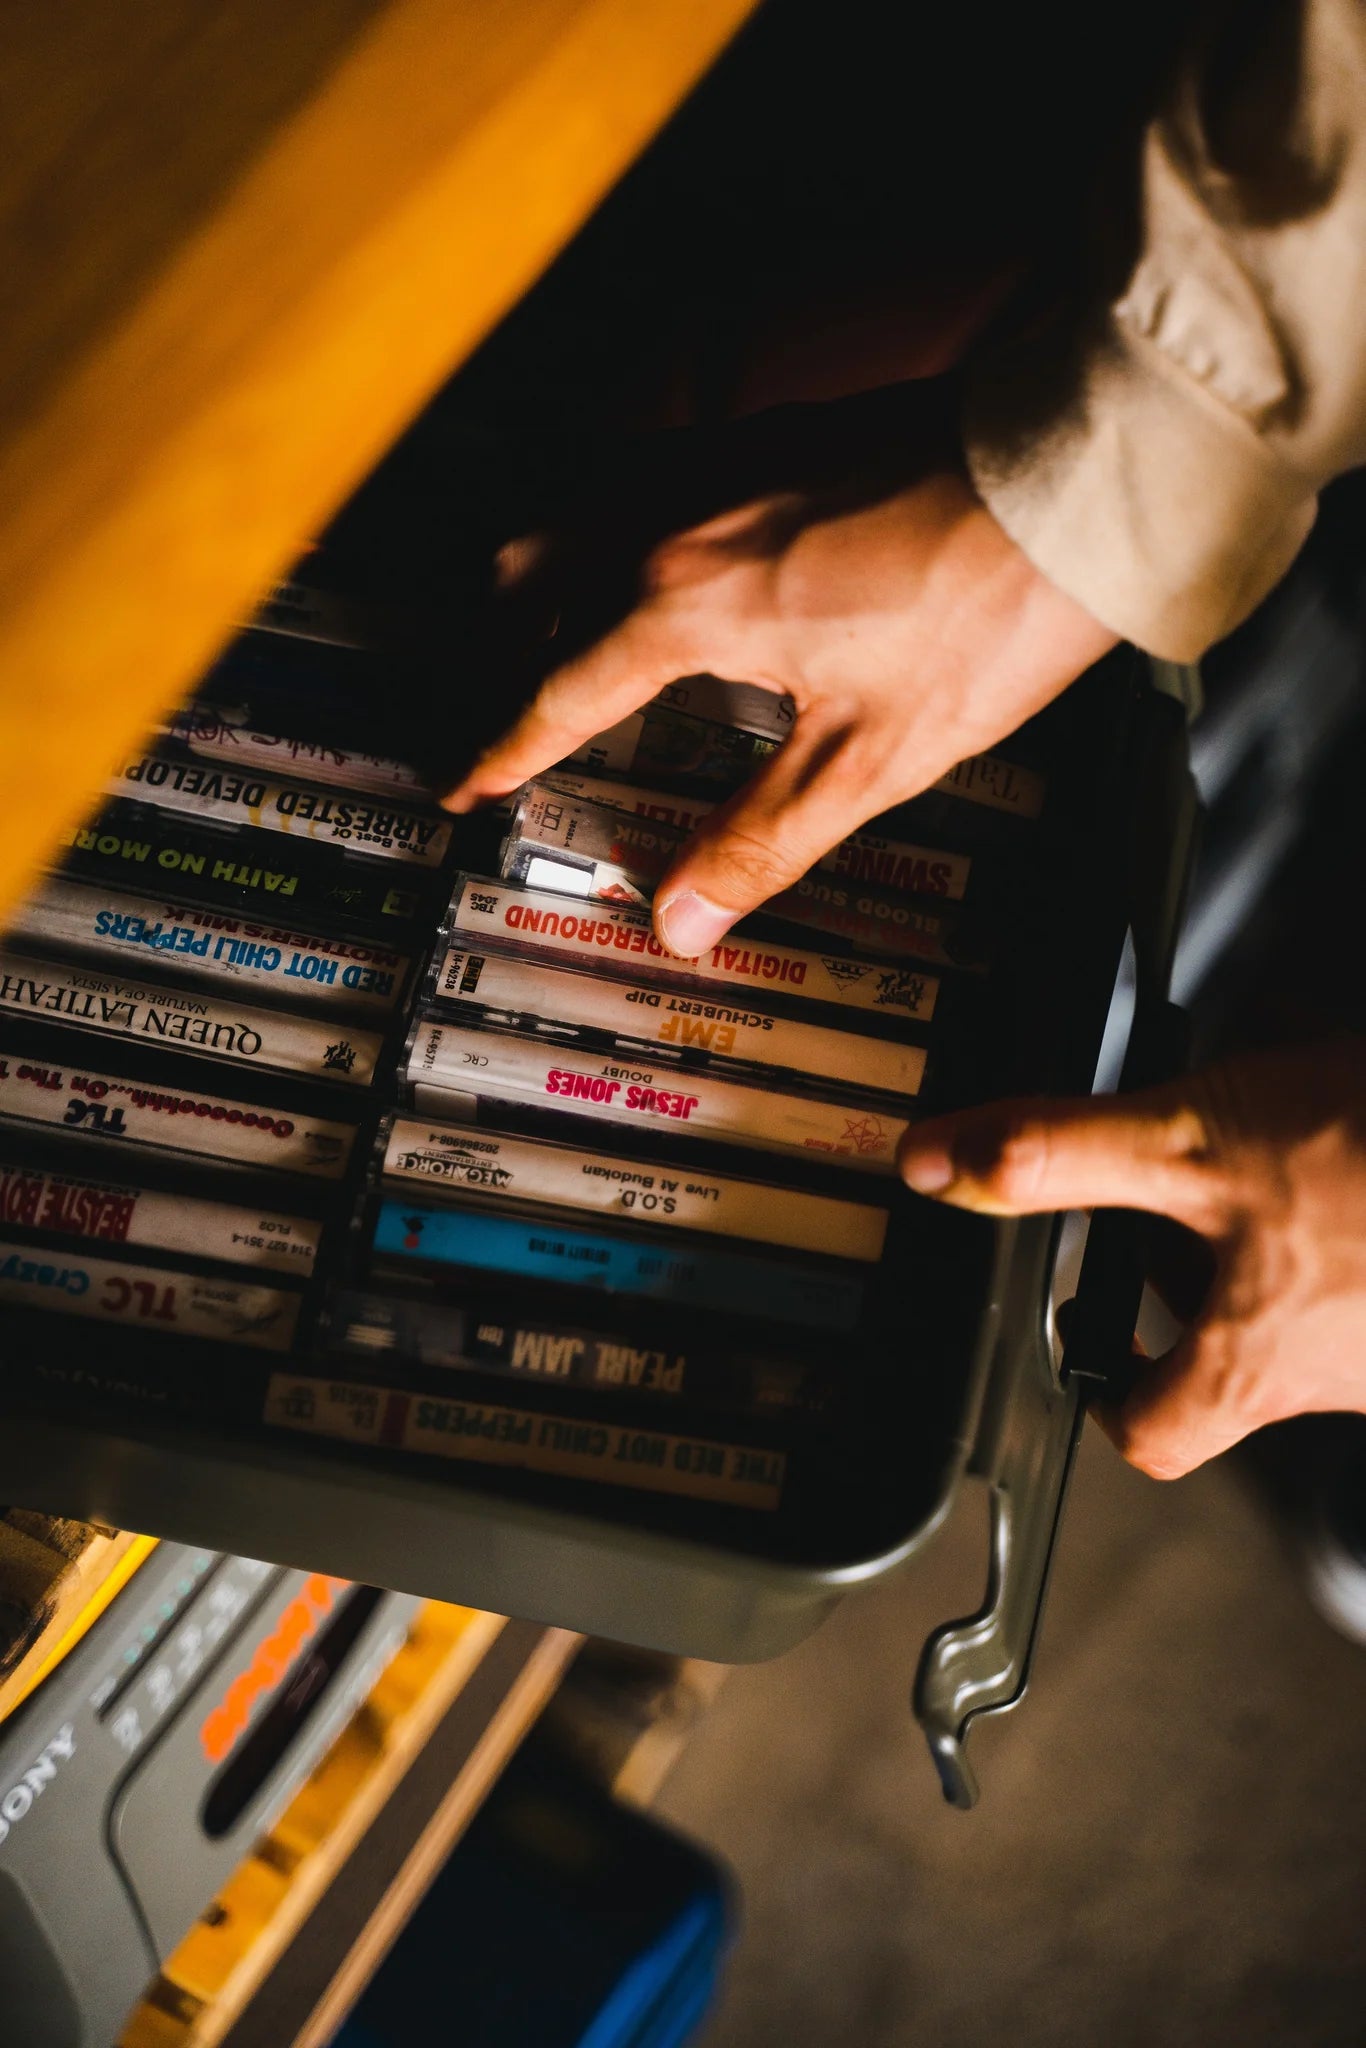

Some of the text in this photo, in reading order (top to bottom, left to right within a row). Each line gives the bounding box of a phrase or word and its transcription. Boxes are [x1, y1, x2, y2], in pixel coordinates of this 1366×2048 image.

[110, 753, 438, 847] ARRESTED DEVELOP
[330, 824, 429, 856] The Best Of
[154, 844, 208, 877] NO
[209, 857, 299, 896] FAITH
[833, 842, 954, 897] SWING
[468, 891, 498, 905] 1045
[469, 900, 495, 914] TBC
[795, 877, 849, 908] SUG
[502, 903, 702, 966] DERGROUND
[853, 894, 941, 936] BLOOD
[92, 908, 395, 997] RED HOT CHILI PEPPERS
[160, 904, 402, 969] MOTHER'S MILK
[443, 951, 464, 991] E4-96238
[710, 943, 808, 985] DIGITAL
[112, 984, 123, 996] A
[122, 986, 145, 1001] OF
[145, 990, 208, 1016] NATURE
[623, 988, 775, 1031] SCHUBERT DIP
[0, 974, 264, 1058] QUEEN LATIFAH
[656, 1012, 738, 1054] EMF
[14, 1063, 64, 1091] The
[461, 1052, 489, 1067] CRC
[599, 1064, 653, 1084] DOUBT
[543, 1068, 700, 1121] JESUS JONES
[61, 1097, 129, 1134] TLC
[394, 1152, 515, 1189] MEGAFORCE
[421, 1149, 493, 1167] ENTERTAINMENT
[580, 1162, 720, 1201] Live At Budokan
[615, 1186, 677, 1214] S.O.D.
[37, 1183, 136, 1243] BEASTIE
[97, 1274, 182, 1322] TLC
[474, 1322, 686, 1395] PEARL JAM ten
[413, 1398, 782, 1486] THE RED HOT CHILI PEPPERS
